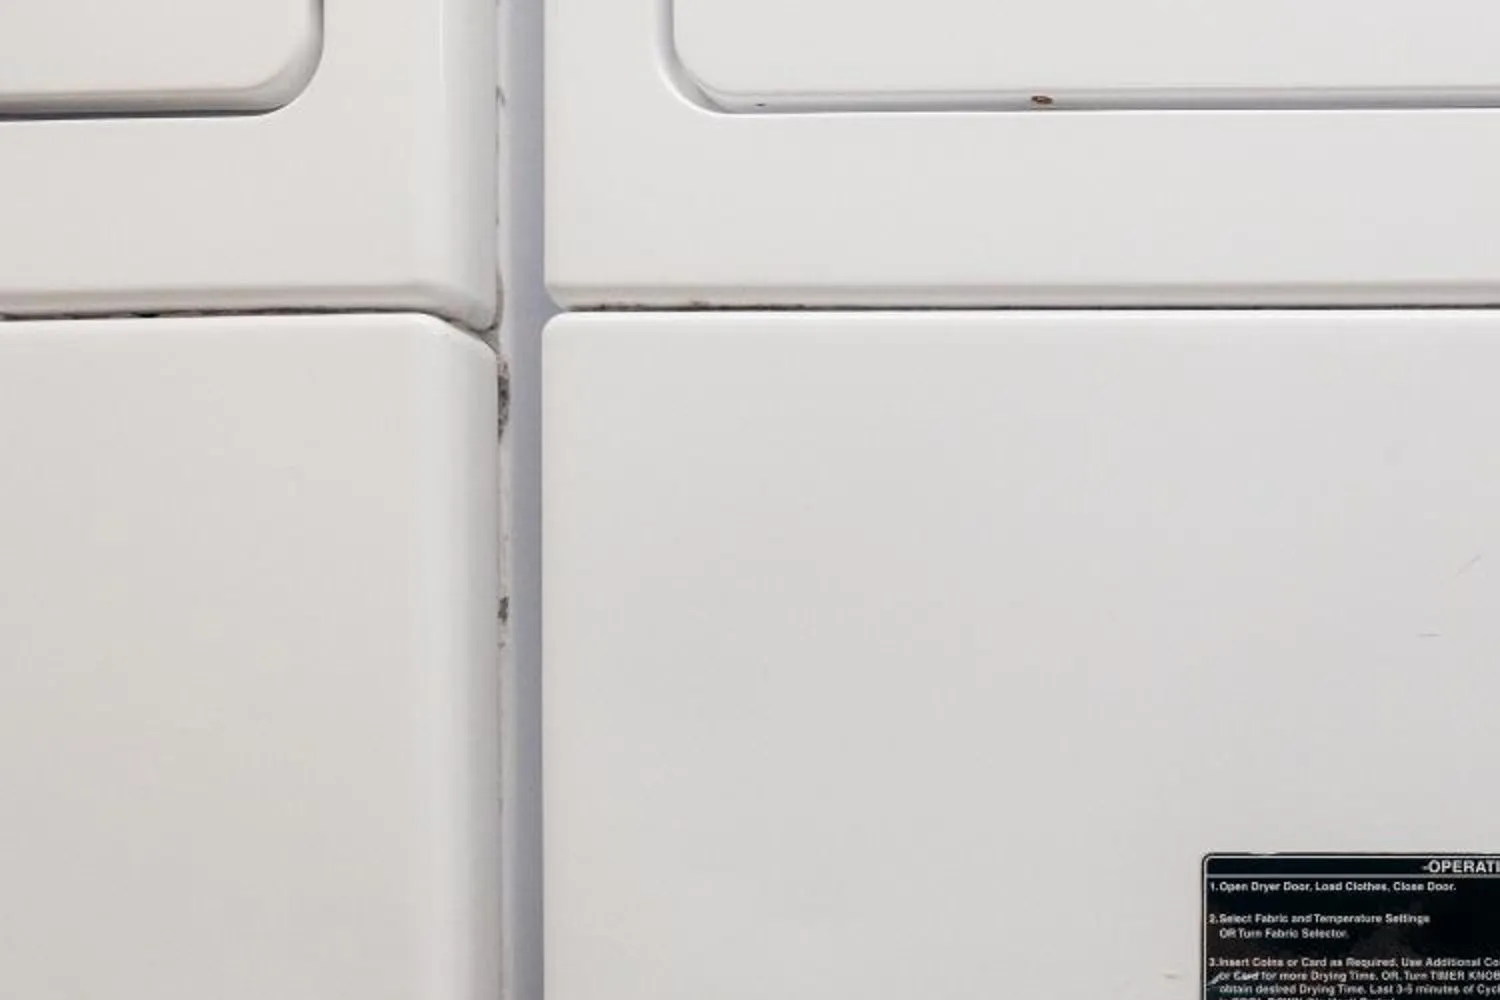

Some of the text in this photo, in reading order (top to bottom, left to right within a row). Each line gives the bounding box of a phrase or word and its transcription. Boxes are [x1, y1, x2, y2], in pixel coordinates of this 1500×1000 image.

[1251, 882, 1281, 893] Dryer
[1315, 882, 1342, 891] Load
[1393, 882, 1424, 891] Close
[1427, 882, 1456, 891] Door.
[1255, 914, 1289, 923] Fabric
[1291, 914, 1313, 923] and
[1314, 914, 1382, 924] Temperature
[1385, 914, 1430, 924] Settings
[1219, 928, 1236, 938] OR
[1238, 928, 1262, 938] Turn
[1265, 928, 1299, 938] Fabric
[1252, 957, 1284, 967] Coins
[1287, 957, 1298, 967] or
[1301, 957, 1327, 967] Card
[1330, 957, 1343, 967] as
[1401, 957, 1422, 967] Use
[1425, 957, 1481, 967] Additional
[1234, 971, 1259, 980] Card
[1261, 971, 1277, 980] for
[1311, 971, 1347, 982] Drying
[1404, 971, 1428, 980] Turn
[1430, 971, 1465, 980] TIMER
[1219, 985, 1253, 994] obtain
[1256, 985, 1297, 994] desired
[1300, 985, 1335, 995] Drying
[1370, 985, 1393, 994] Last
[1396, 985, 1413, 994] 3-5
[1415, 985, 1459, 994] minutes
[1463, 985, 1474, 994] of
